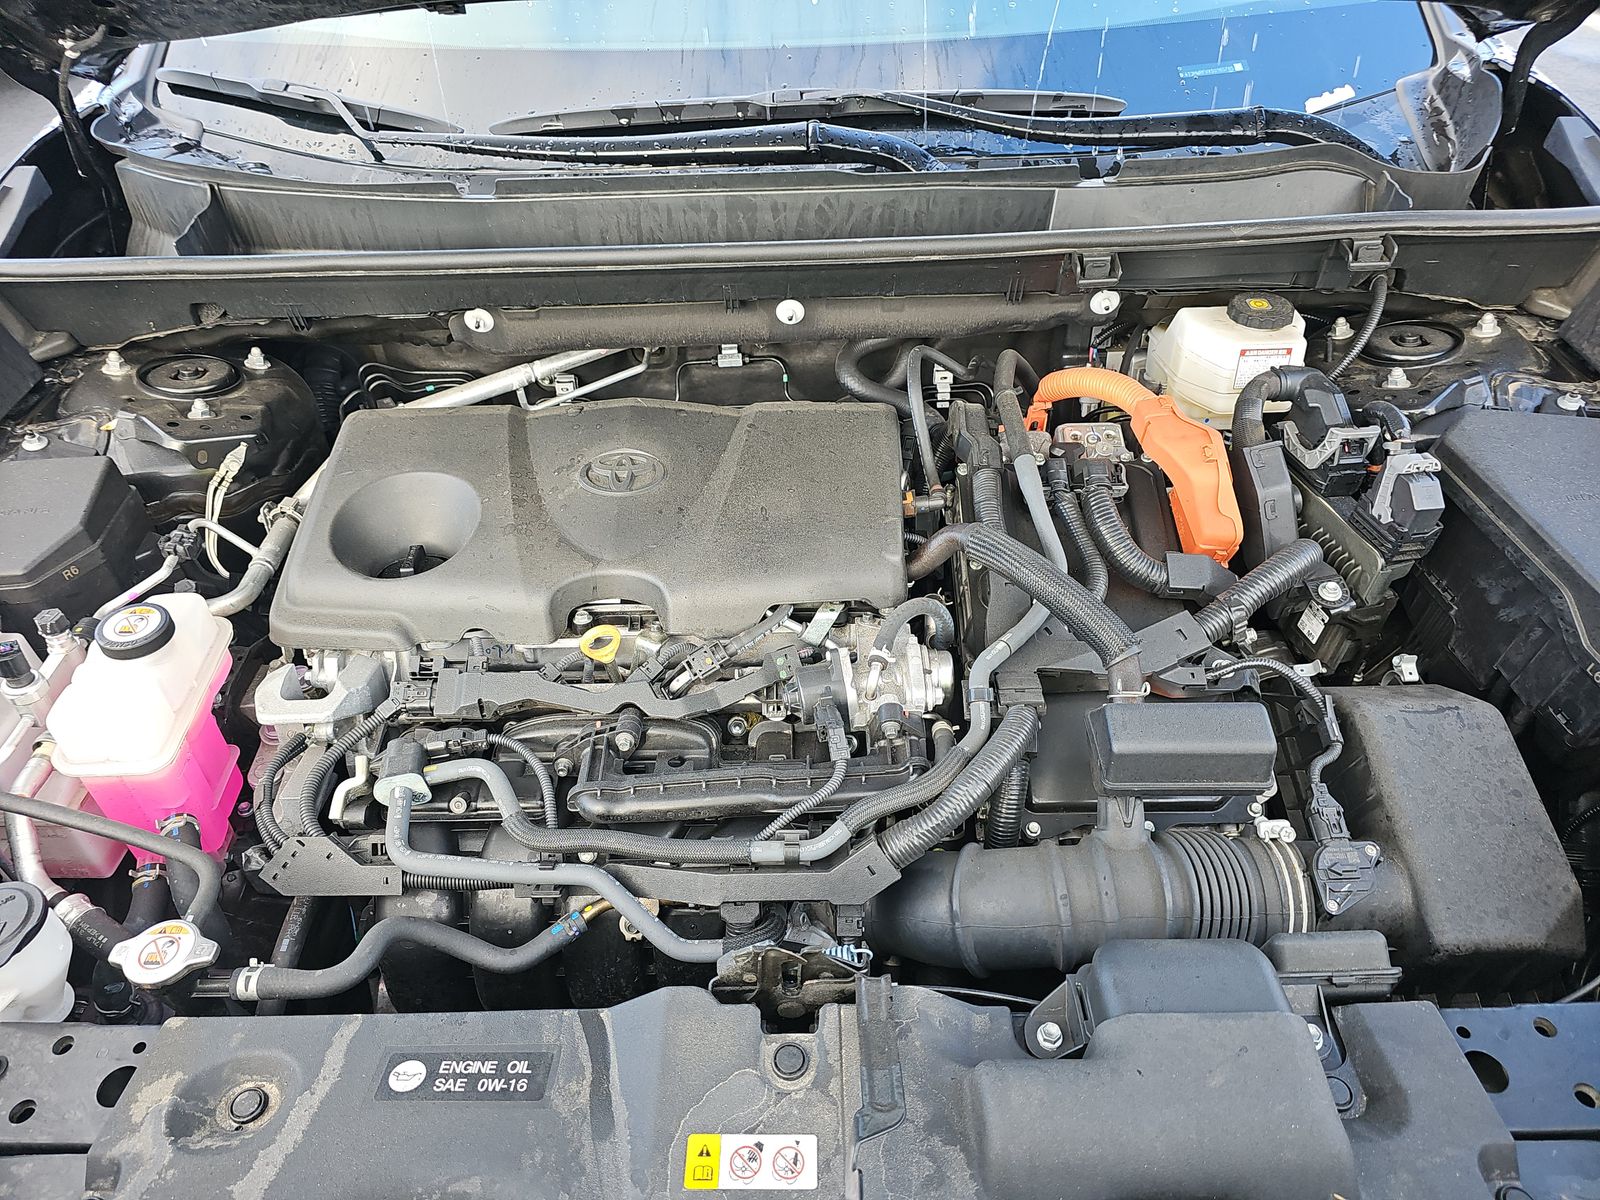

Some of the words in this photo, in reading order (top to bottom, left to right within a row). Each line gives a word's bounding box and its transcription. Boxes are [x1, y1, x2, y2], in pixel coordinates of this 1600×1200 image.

[62, 565, 80, 581] R6
[438, 1060, 498, 1074] ENGINE
[506, 1060, 532, 1074] OIL
[432, 1078, 467, 1092] SAE
[477, 1078, 528, 1092] 0W-16
